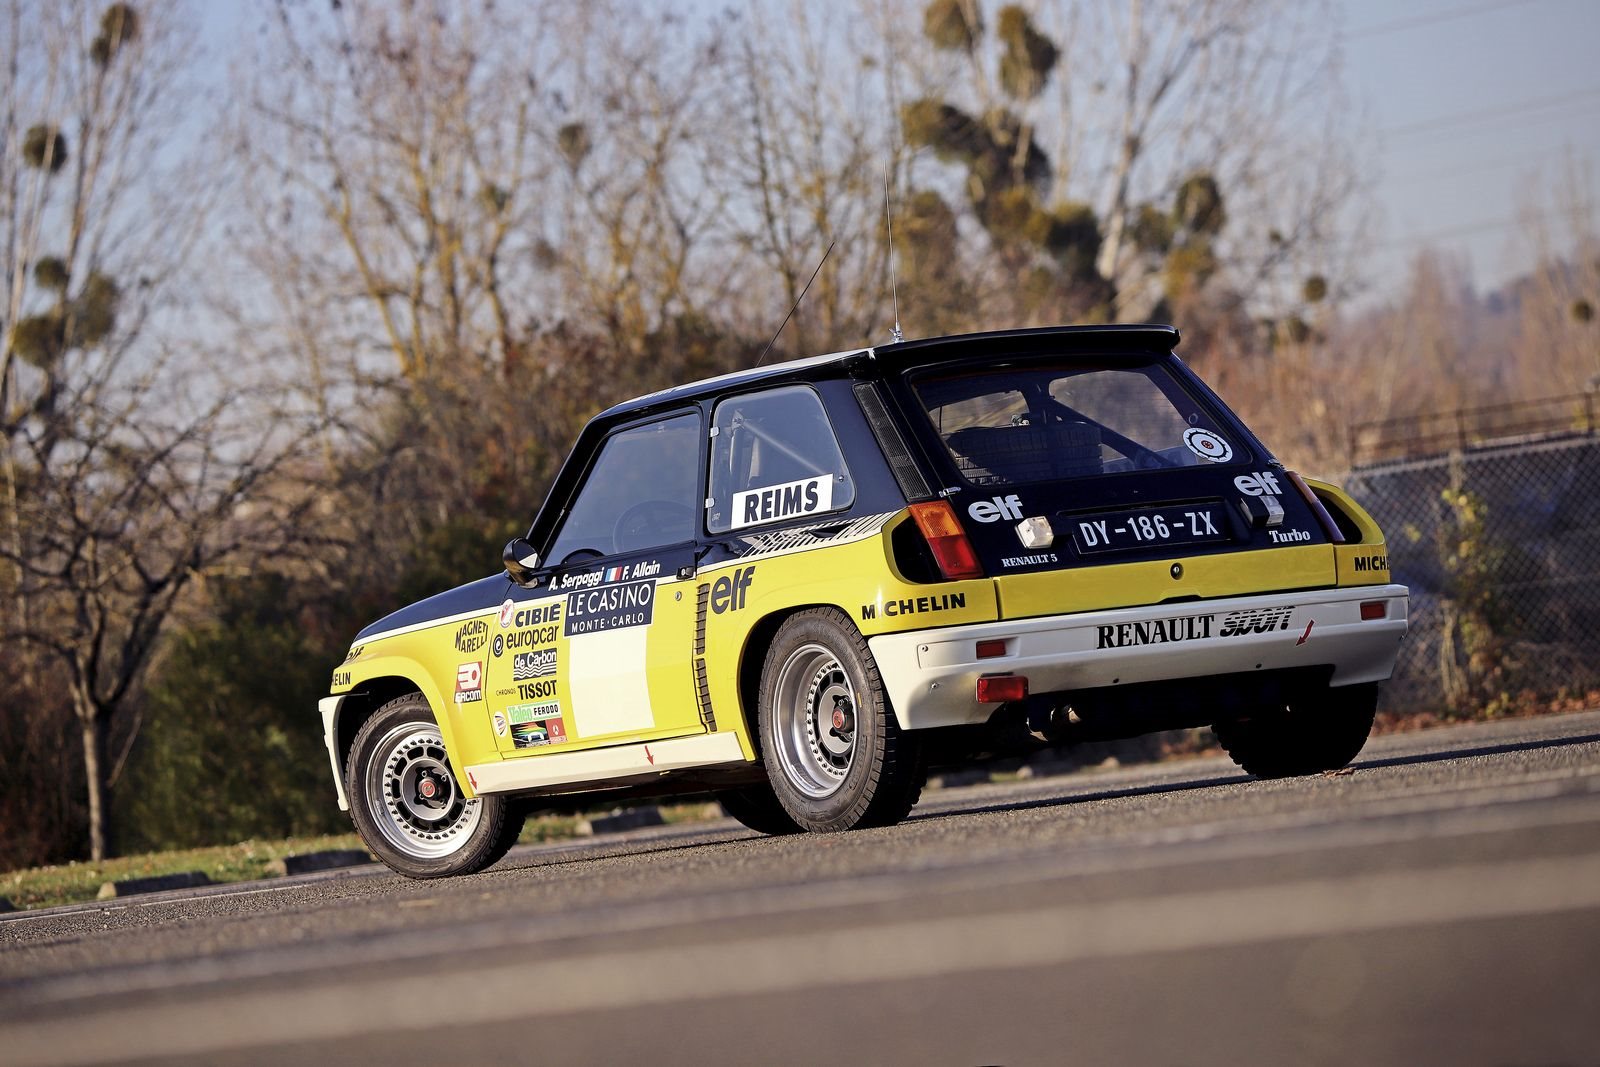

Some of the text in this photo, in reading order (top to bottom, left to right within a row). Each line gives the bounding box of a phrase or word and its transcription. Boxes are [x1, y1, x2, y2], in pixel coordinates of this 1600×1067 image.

[1234, 472, 1282, 496] elf
[744, 481, 819, 523] REIMS
[968, 494, 1024, 523] elf
[1269, 529, 1311, 543] Turbo
[1001, 553, 1058, 567] RENAULT 5
[1354, 556, 1389, 571] MICH
[548, 560, 661, 591] A. Serpaggi F. Allain
[568, 583, 651, 616] LE CASINO
[711, 566, 756, 614] elf
[862, 592, 966, 620] MCHELIN
[506, 625, 560, 650] europcar
[1097, 615, 1214, 649] RENAULT
[514, 650, 557, 669] de Carbon
[518, 680, 557, 700] TISSOT
[508, 706, 533, 724] Valeo
[534, 704, 559, 716] FERODO
